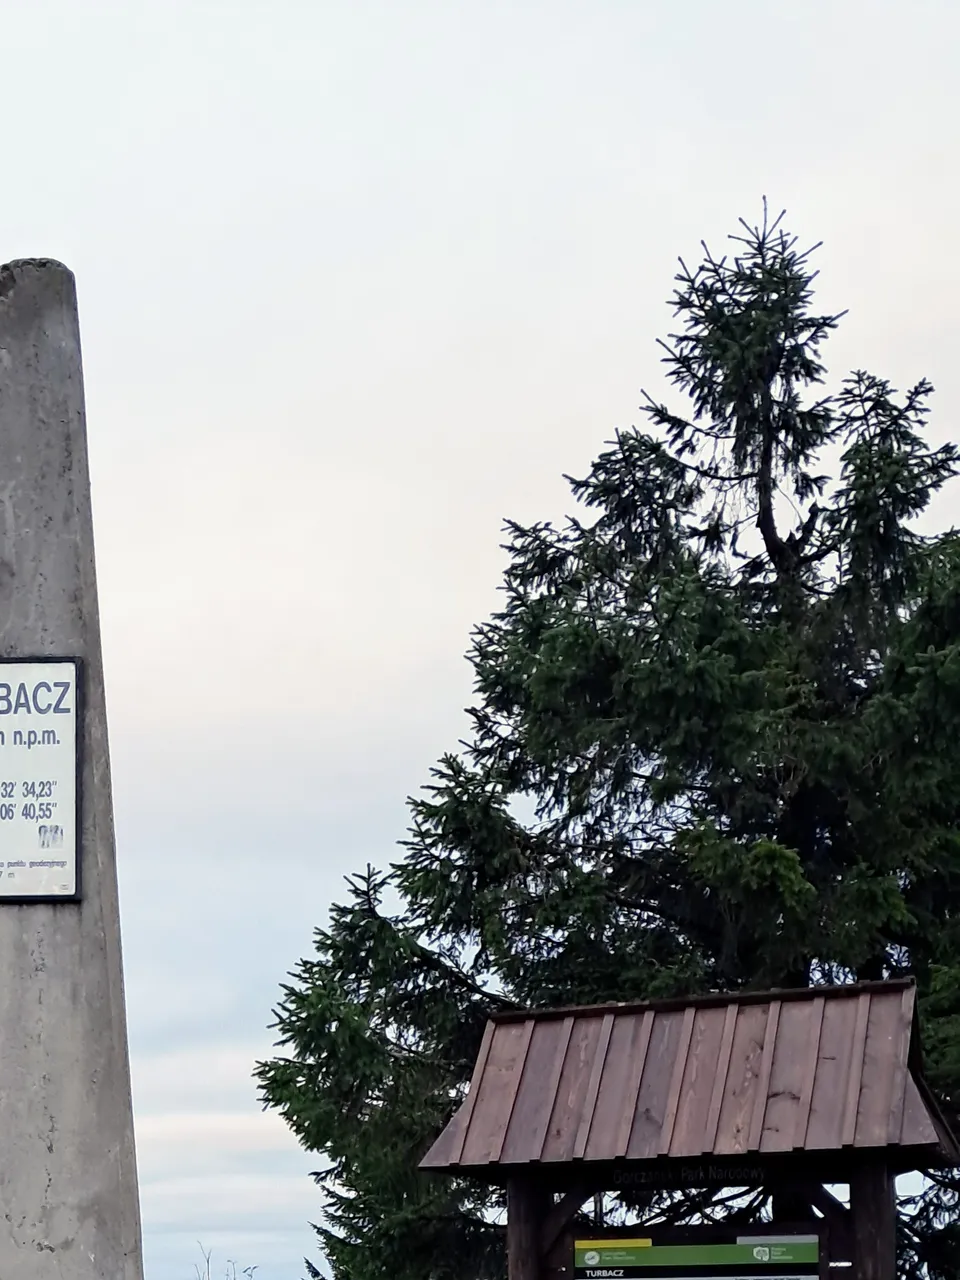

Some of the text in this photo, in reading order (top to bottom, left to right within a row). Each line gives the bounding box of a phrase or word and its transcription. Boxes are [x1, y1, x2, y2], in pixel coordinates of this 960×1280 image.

[13, 729, 61, 750] n.p.m.
[681, 1166, 705, 1181] Park
[585, 1269, 624, 1277] TURBACZ
